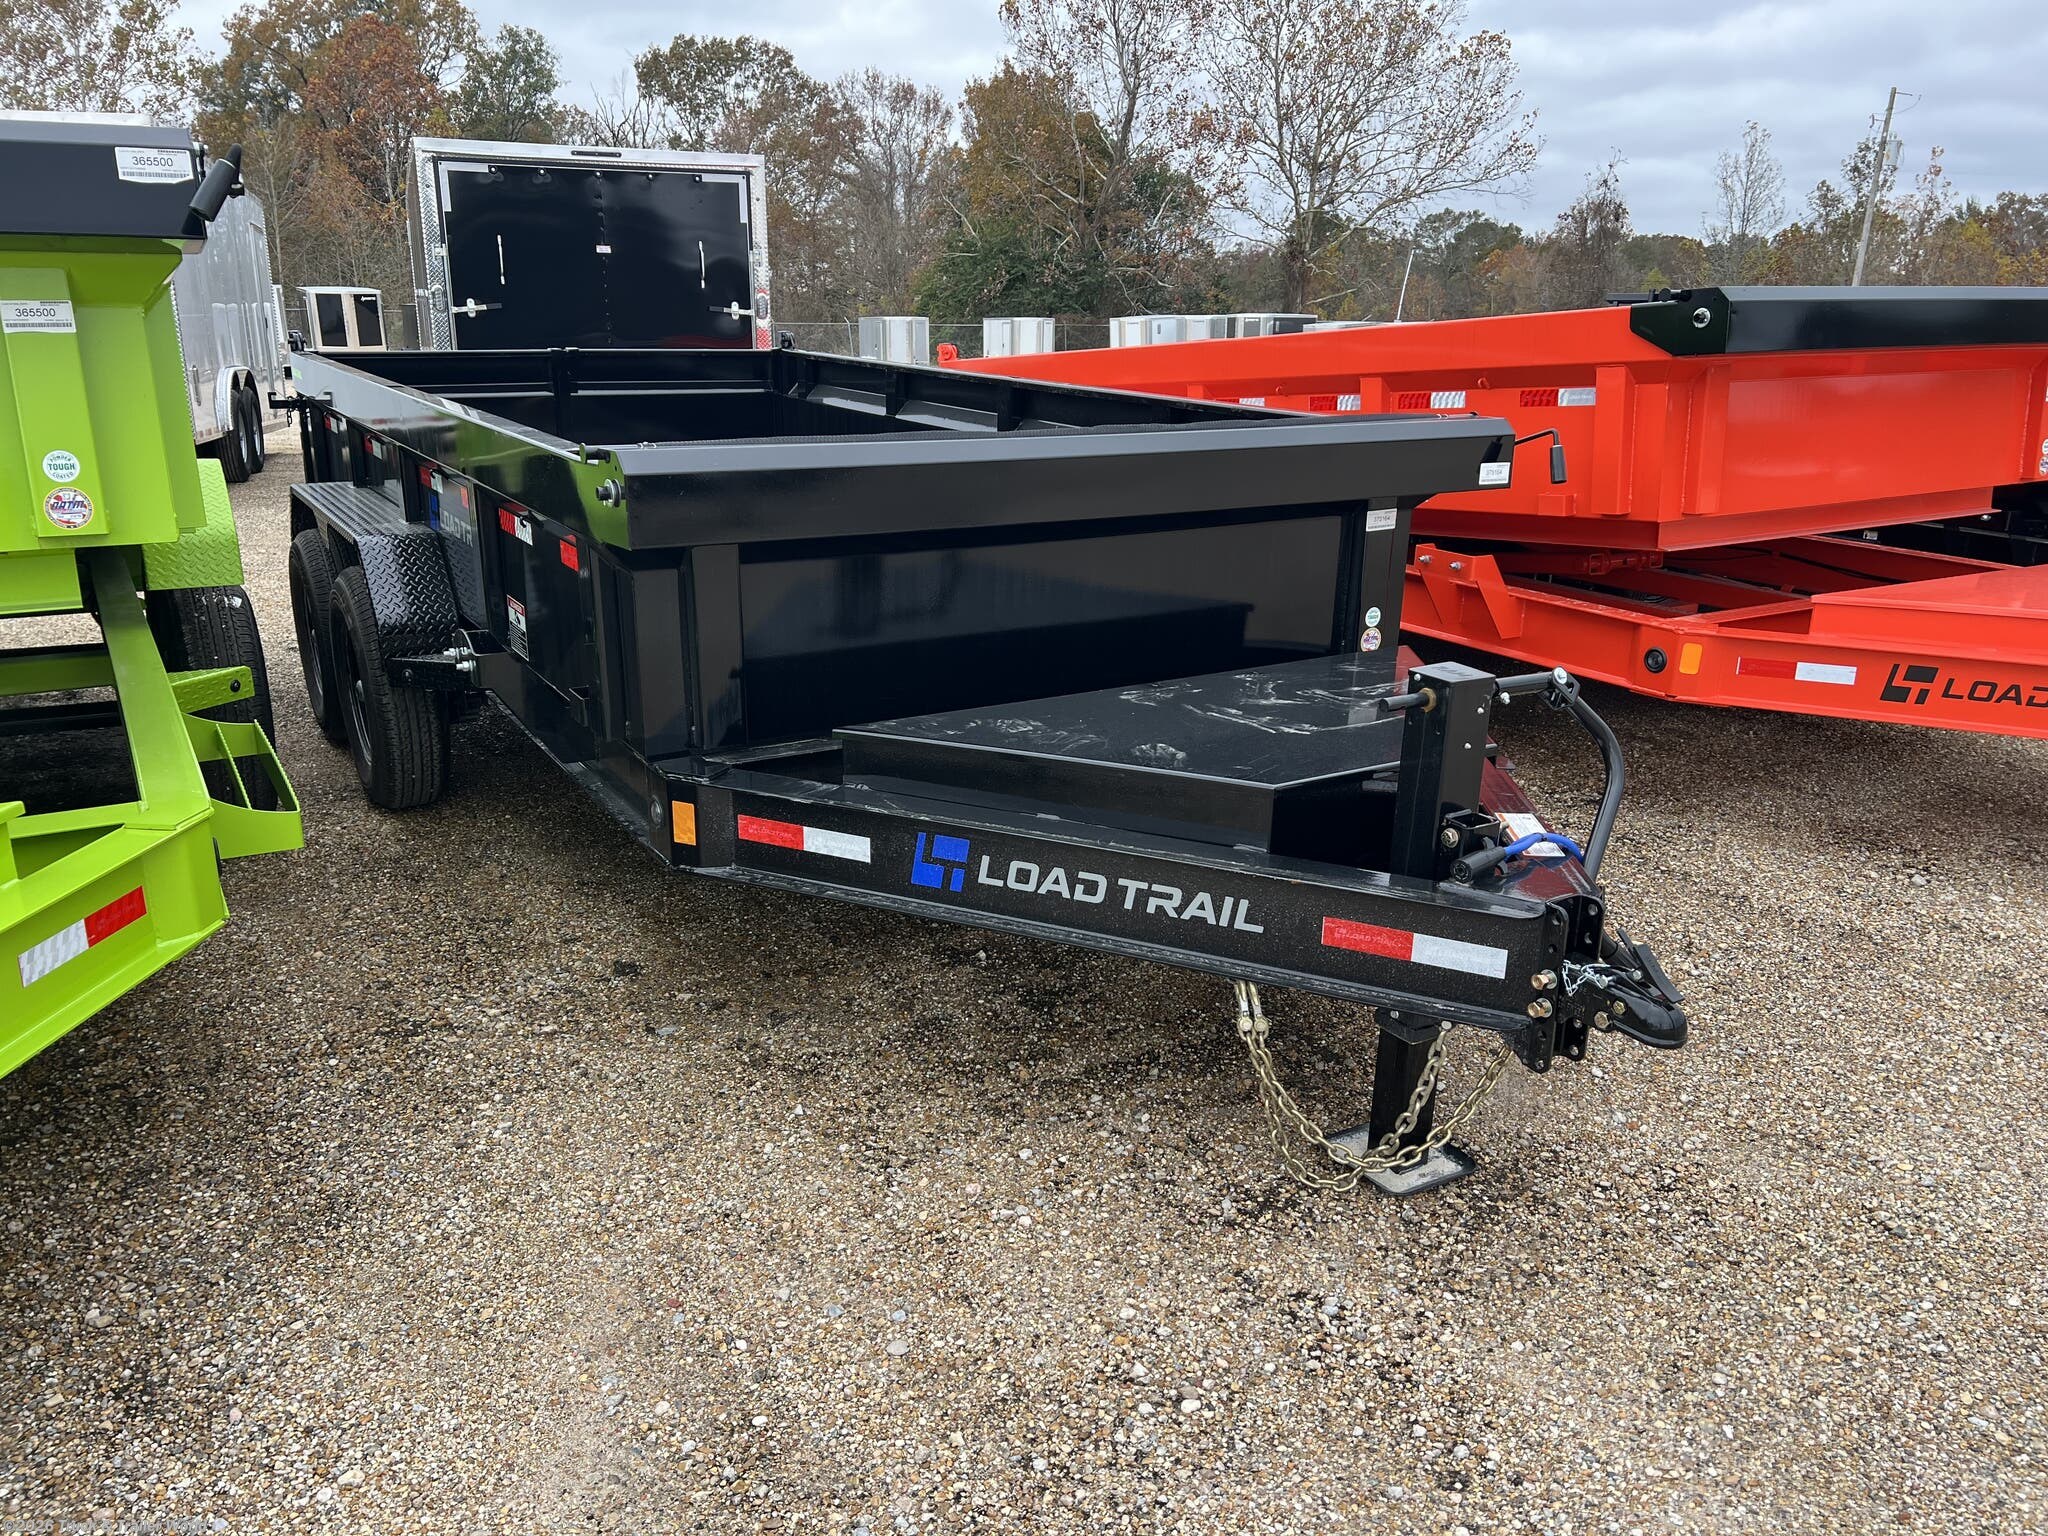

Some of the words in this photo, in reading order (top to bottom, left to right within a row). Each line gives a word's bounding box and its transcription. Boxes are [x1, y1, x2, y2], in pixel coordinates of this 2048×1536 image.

[131, 156, 174, 167] 365500
[15, 308, 56, 317] 365500
[48, 463, 76, 471] TOUGH
[440, 508, 461, 539] LOAD
[1942, 678, 2048, 707] LOAD
[977, 855, 1108, 905] LOAD
[1117, 877, 1265, 934] TRAIL
